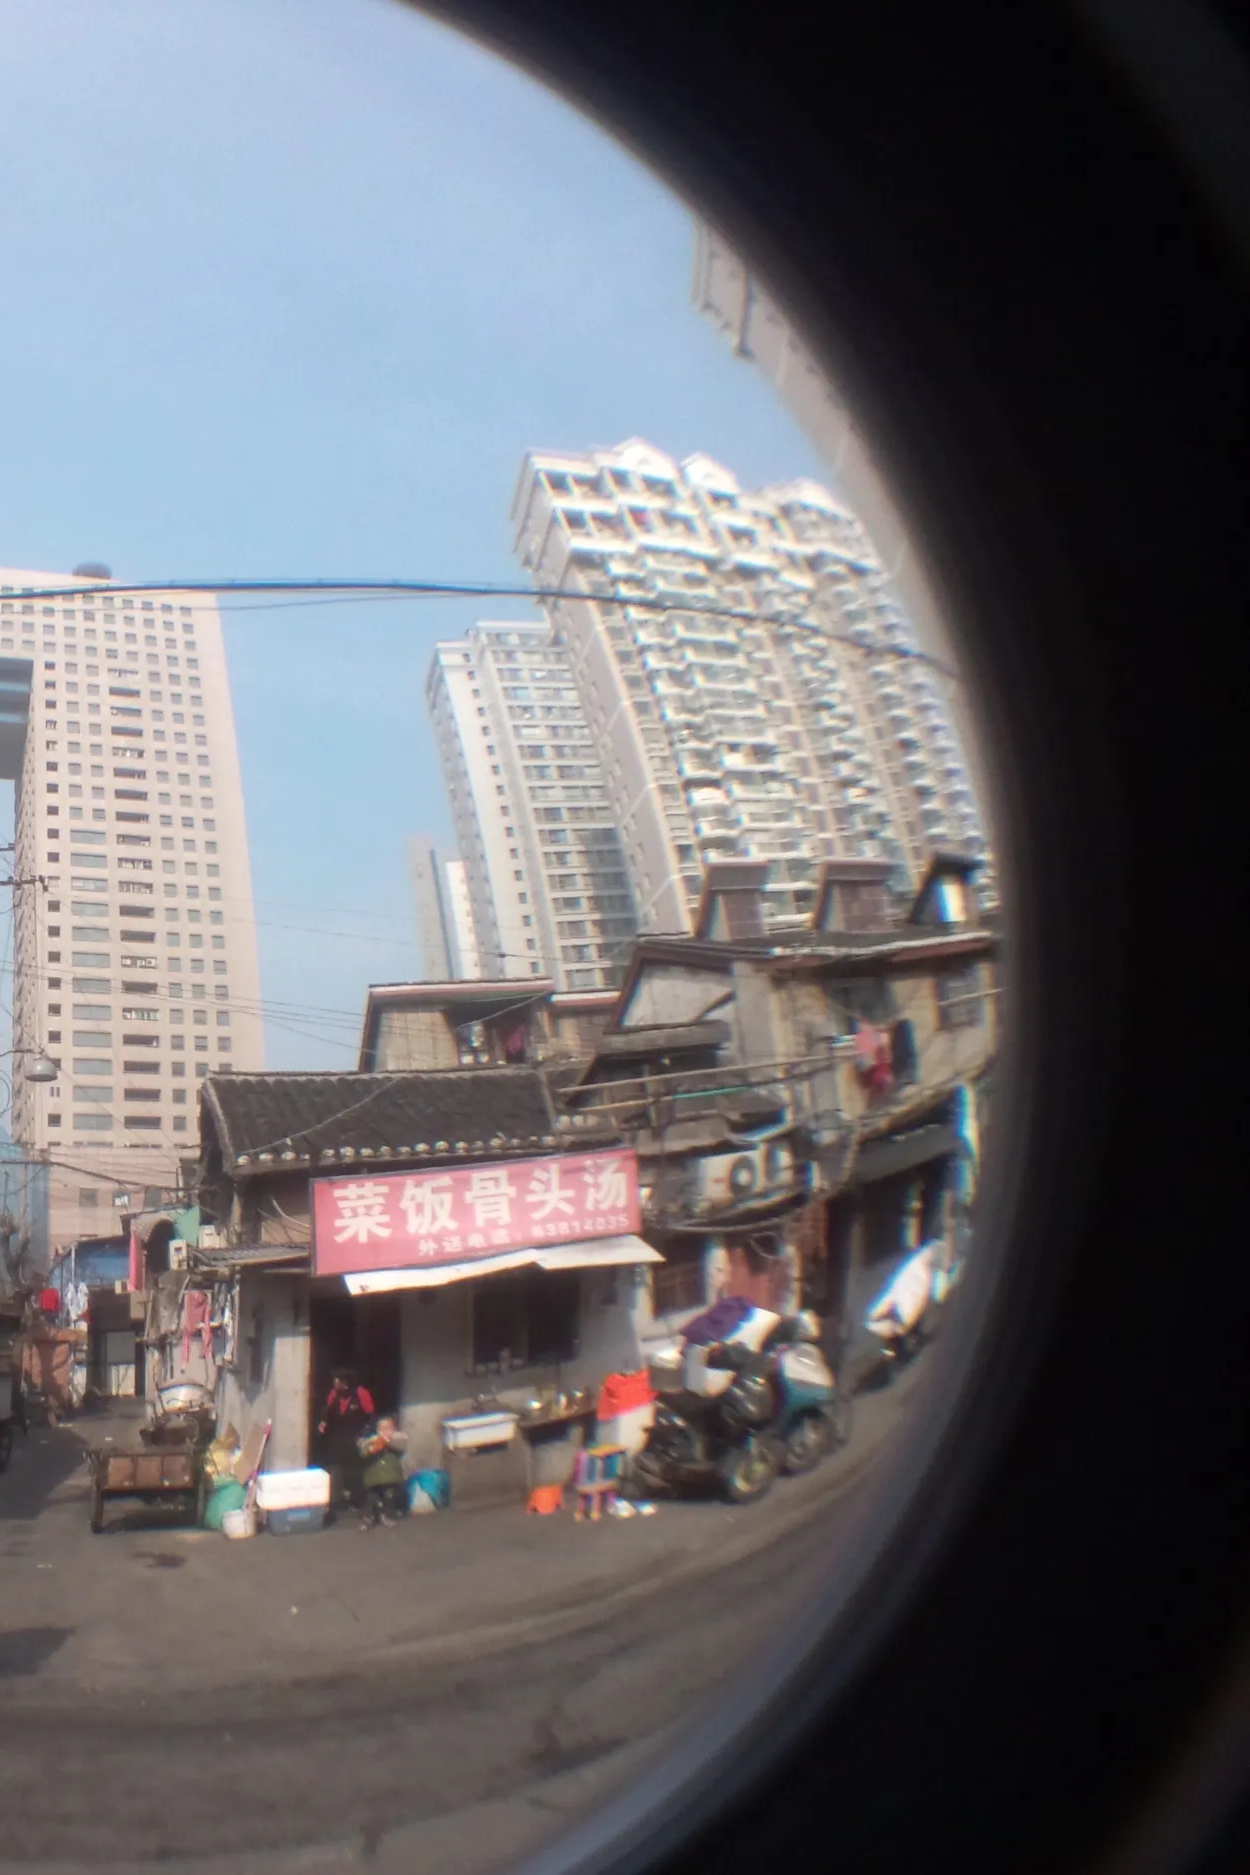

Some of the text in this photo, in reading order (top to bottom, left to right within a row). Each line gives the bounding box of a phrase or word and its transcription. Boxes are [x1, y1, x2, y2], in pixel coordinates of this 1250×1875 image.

[333, 1158, 628, 1244] 菜饭骨头汤
